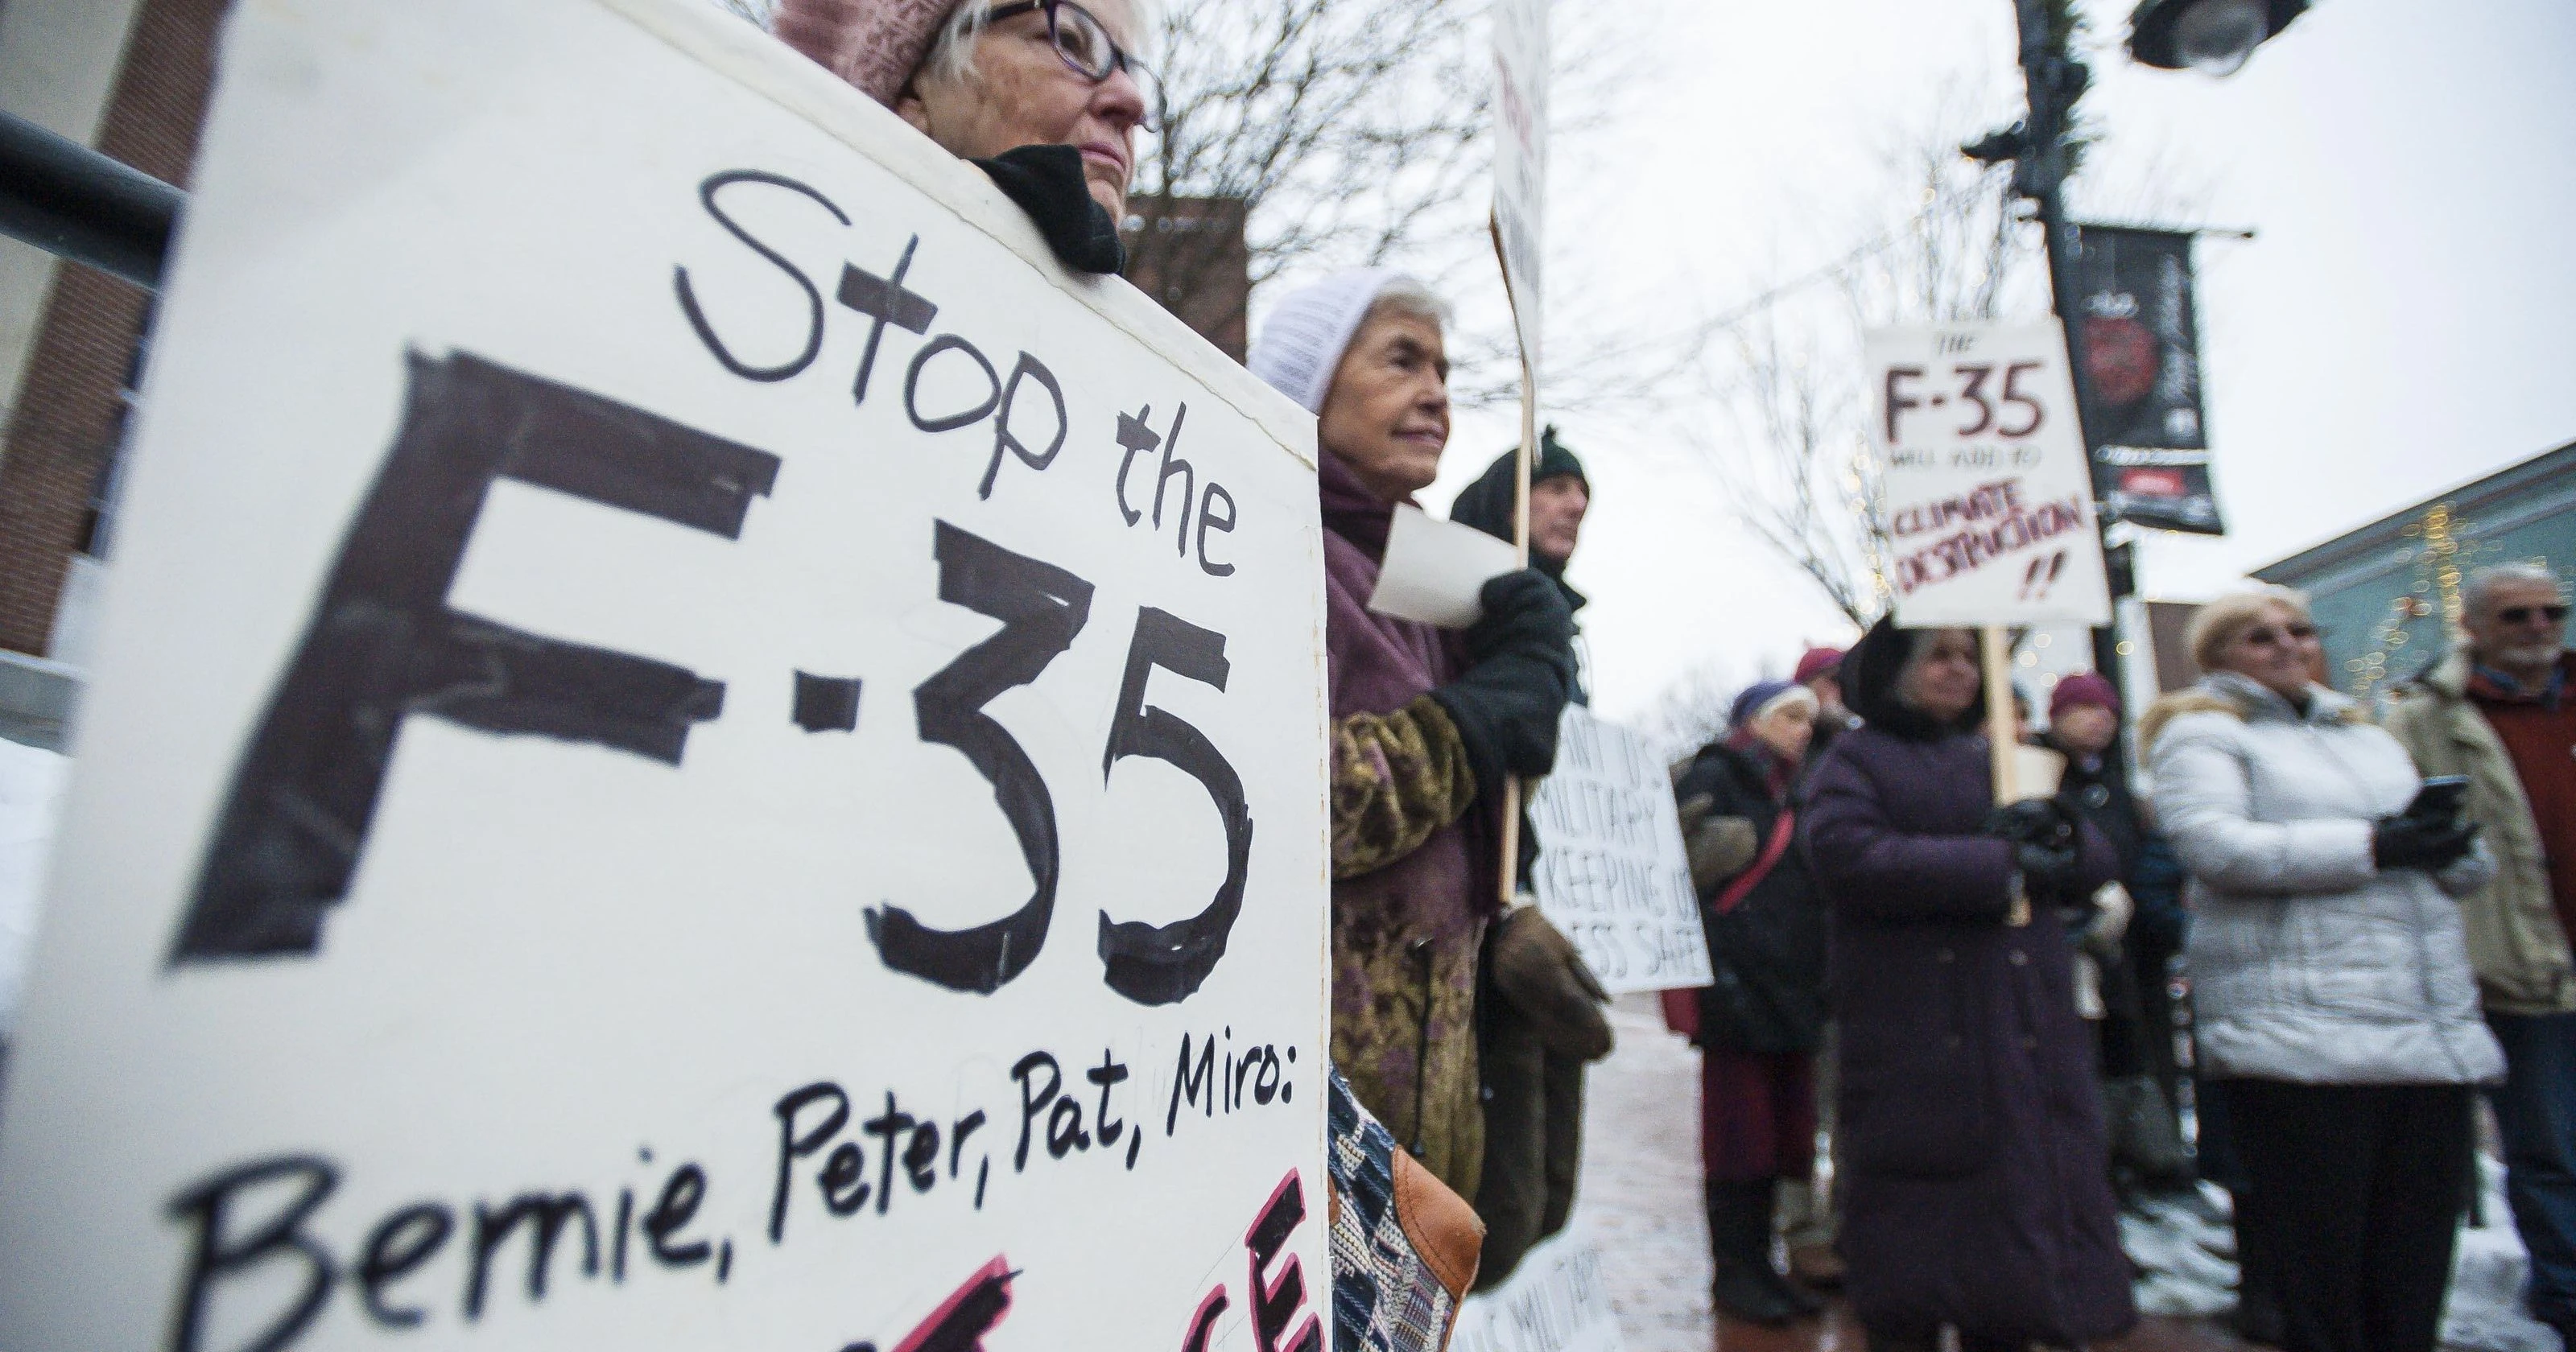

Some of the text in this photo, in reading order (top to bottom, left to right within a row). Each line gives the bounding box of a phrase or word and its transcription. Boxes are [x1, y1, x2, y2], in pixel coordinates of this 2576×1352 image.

[674, 167, 1238, 579] Stop the
[1884, 360, 2047, 444] F-35
[1893, 476, 2024, 538] CLIMATE
[1894, 495, 2087, 596] DESTRUCTION
[163, 344, 1254, 1008] F-35
[766, 1080, 990, 1245] Peter,
[1009, 1047, 1142, 1172] Pat,
[1165, 1024, 1297, 1137] Miro:
